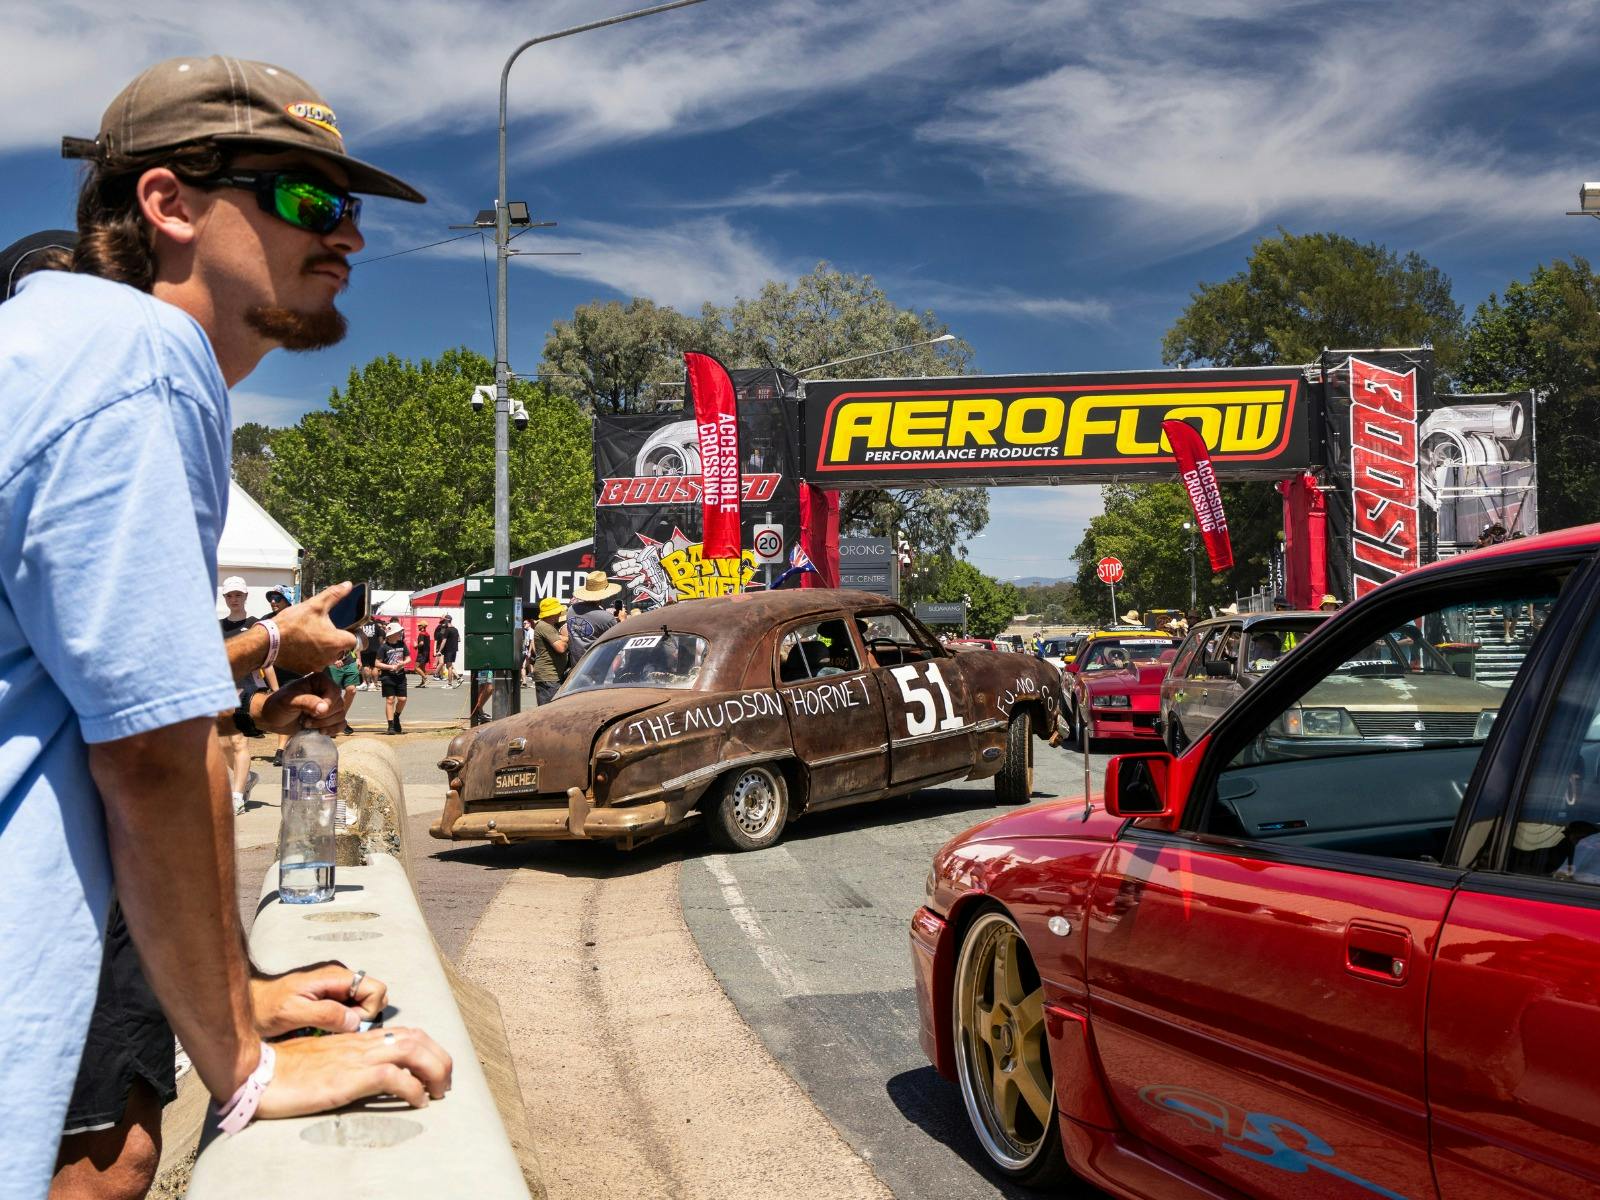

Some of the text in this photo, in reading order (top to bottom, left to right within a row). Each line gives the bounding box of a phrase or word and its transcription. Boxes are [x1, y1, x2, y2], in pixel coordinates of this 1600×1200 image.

[830, 390, 1285, 462] AEROFLOW
[699, 423, 719, 505] CROSSING
[718, 413, 738, 513] ACCESSIBLE
[865, 446, 1059, 462] PERFORMANCE PRODUCTS
[597, 473, 782, 506] BOOSD
[1183, 469, 1216, 533] CROSSING
[1195, 459, 1228, 533] ACCESSIBLE
[1349, 357, 1421, 602] BOOST
[759, 537, 778, 550] 20
[676, 576, 741, 600] SHIFT
[857, 575, 886, 583] CENTRE
[1098, 563, 1122, 578] STOP
[630, 637, 656, 647] 1077
[629, 675, 870, 744] THE MUDSON HORNET
[890, 662, 964, 736] 51
[496, 772, 537, 788] SANCHEZ
